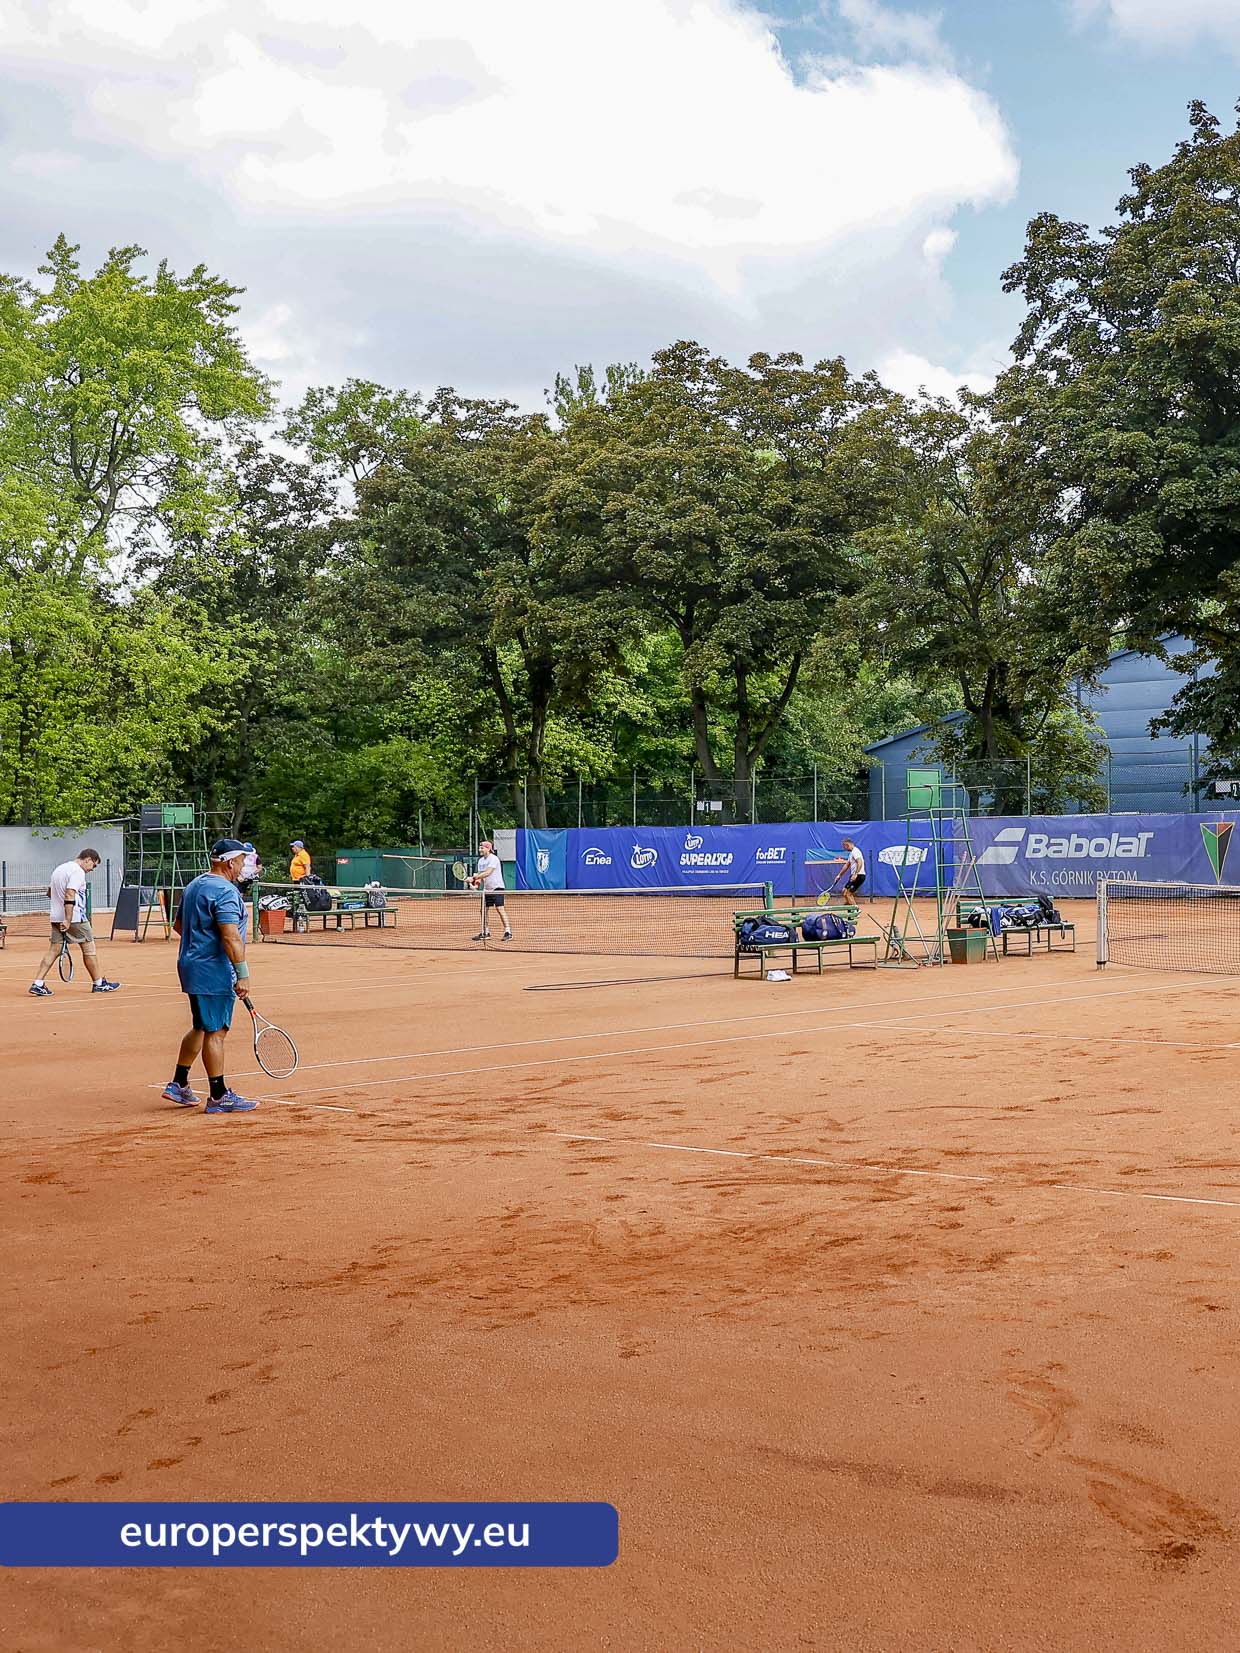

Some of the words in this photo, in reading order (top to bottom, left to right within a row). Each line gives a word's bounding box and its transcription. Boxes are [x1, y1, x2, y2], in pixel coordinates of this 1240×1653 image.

[1231, 783, 1238, 797] 2
[585, 854, 612, 865] Enea
[756, 847, 786, 860] forBET
[1030, 870, 1050, 885] K.S.
[1051, 868, 1094, 886] GÓRNIK
[765, 930, 790, 939] HEA
